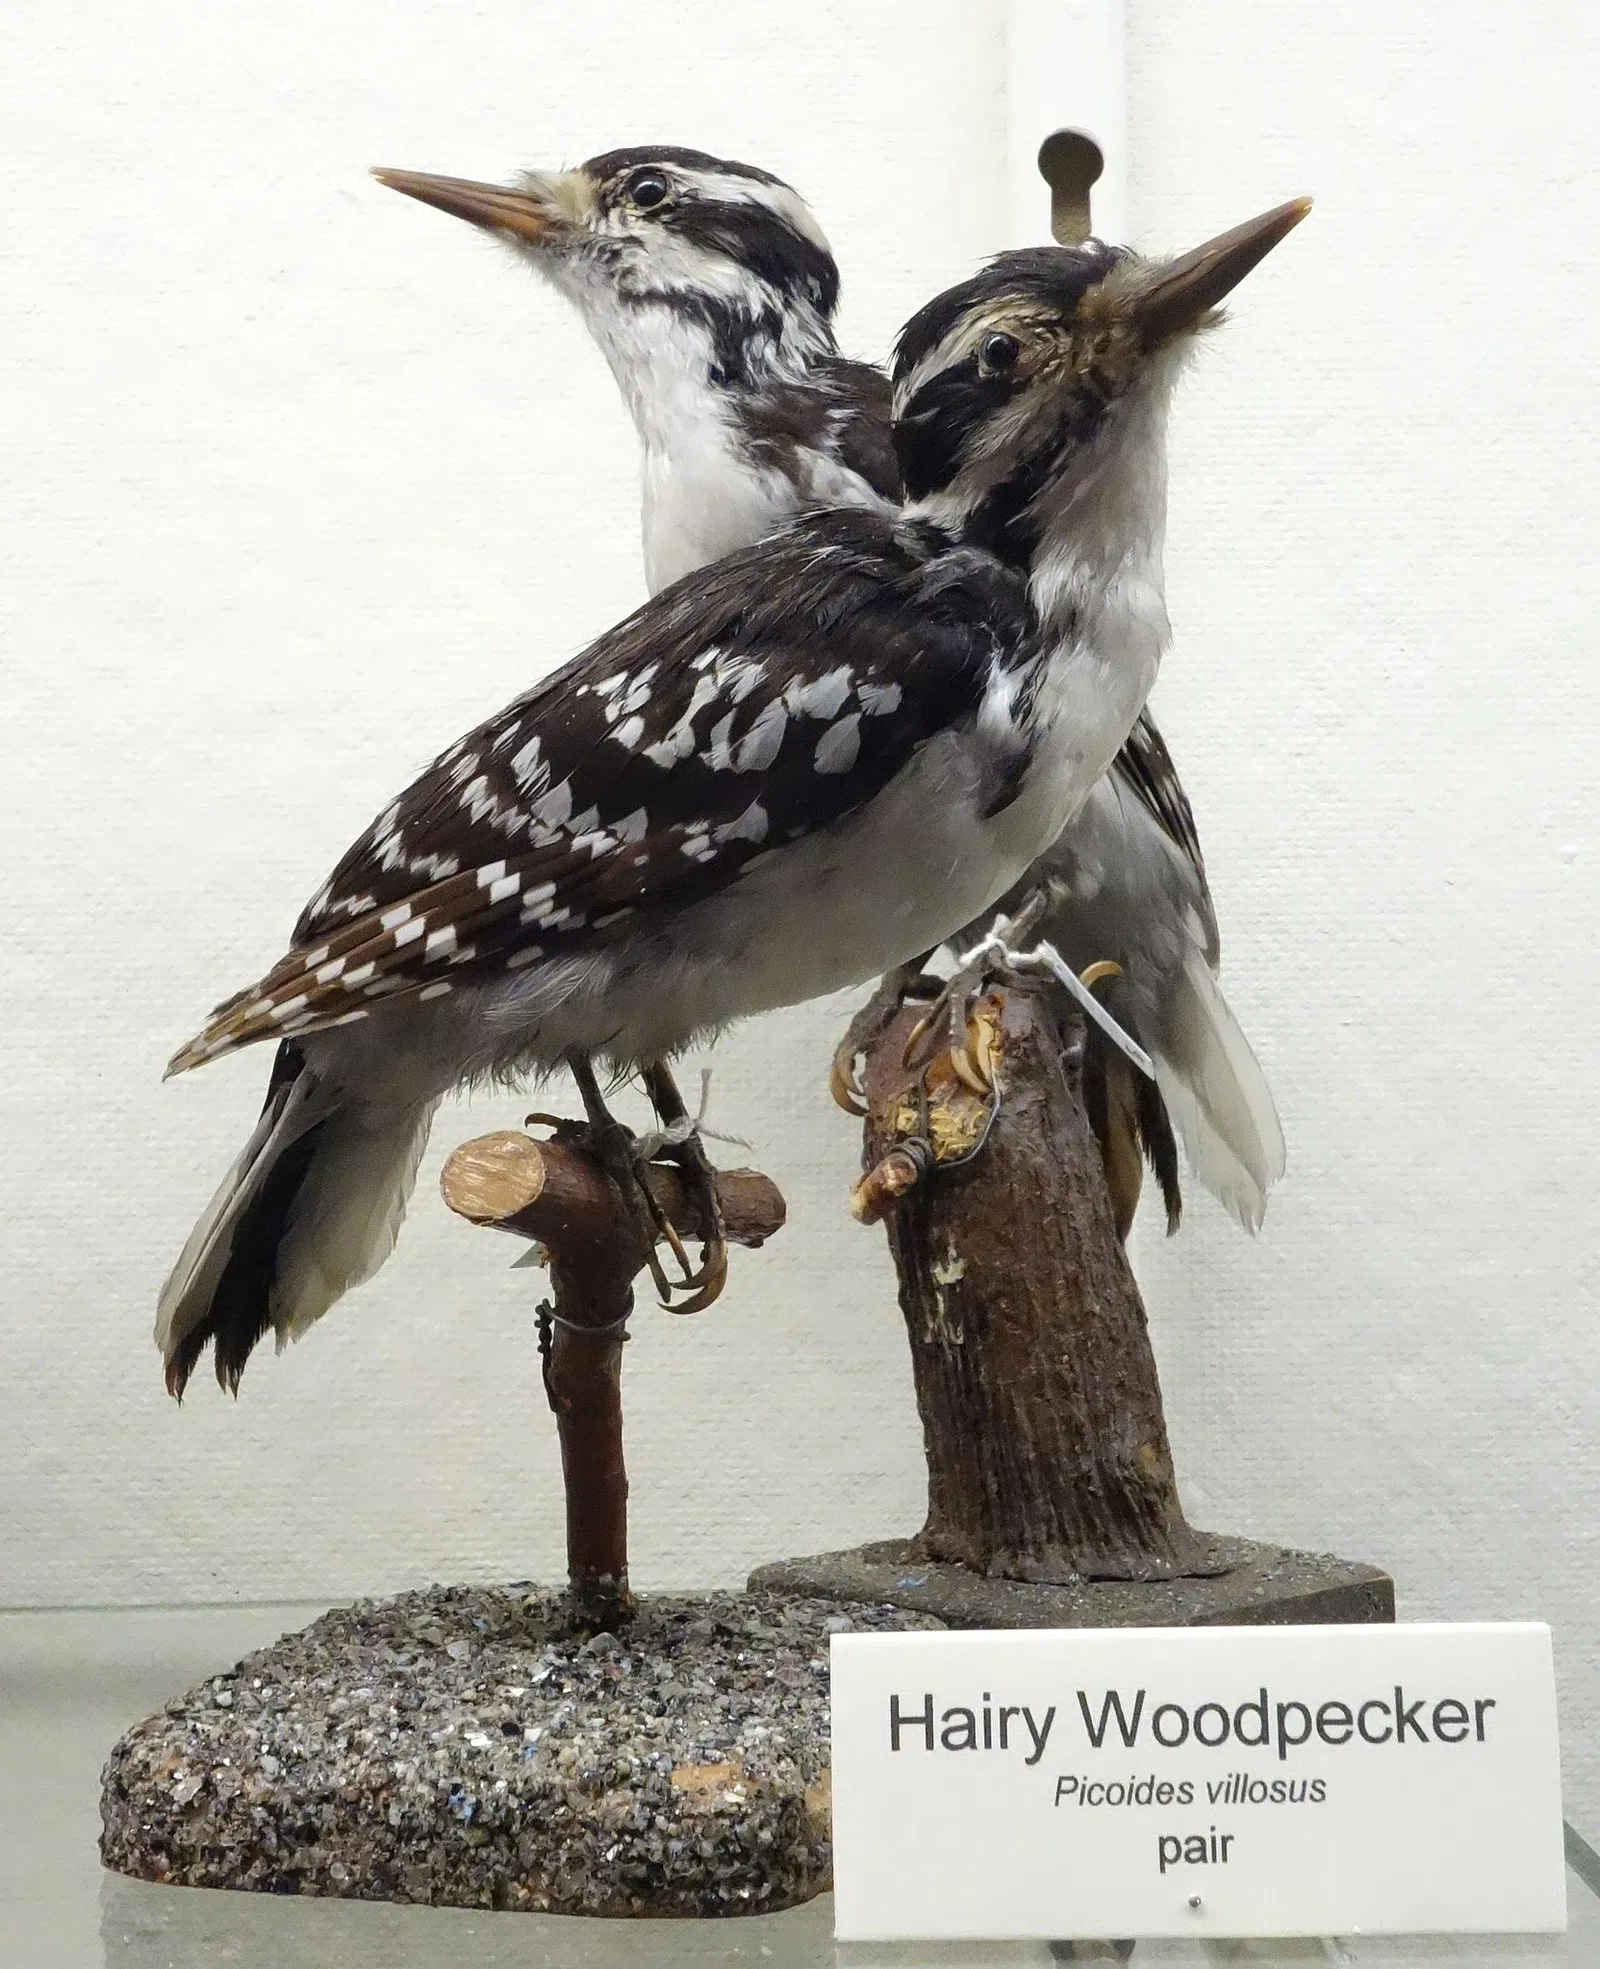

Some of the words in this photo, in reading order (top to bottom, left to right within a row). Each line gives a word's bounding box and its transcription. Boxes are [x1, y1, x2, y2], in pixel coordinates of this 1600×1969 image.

[889, 1691, 1057, 1766] Hairy
[1076, 1685, 1497, 1761] Woodpecker
[1054, 1774, 1195, 1807] Picoides
[1206, 1772, 1327, 1805] villosus
[1158, 1825, 1235, 1874] pair
